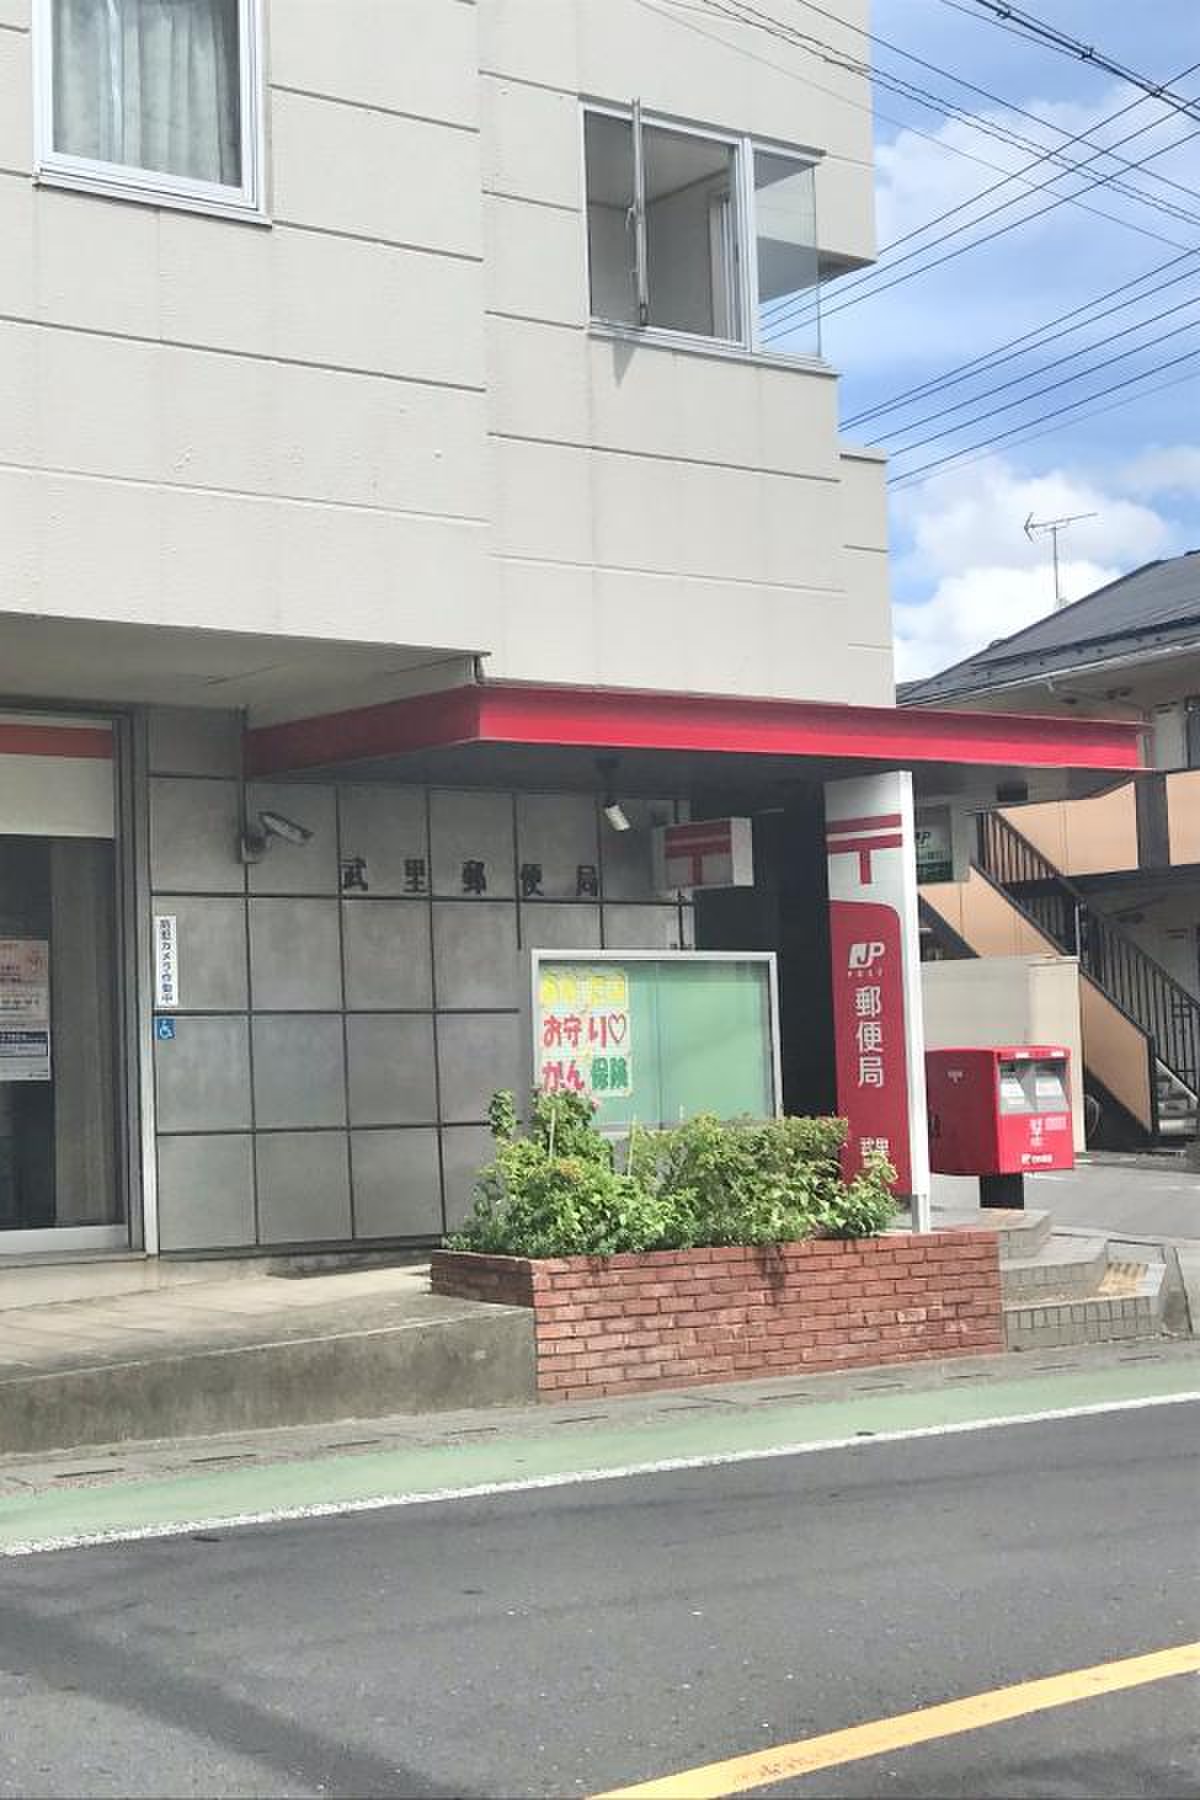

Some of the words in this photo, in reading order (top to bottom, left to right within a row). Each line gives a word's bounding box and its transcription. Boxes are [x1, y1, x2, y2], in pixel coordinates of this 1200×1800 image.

[341, 857, 598, 897] 武里郵便局
[848, 942, 885, 969] JP
[543, 1015, 607, 1048] お守り
[855, 985, 884, 1088] 郵便局
